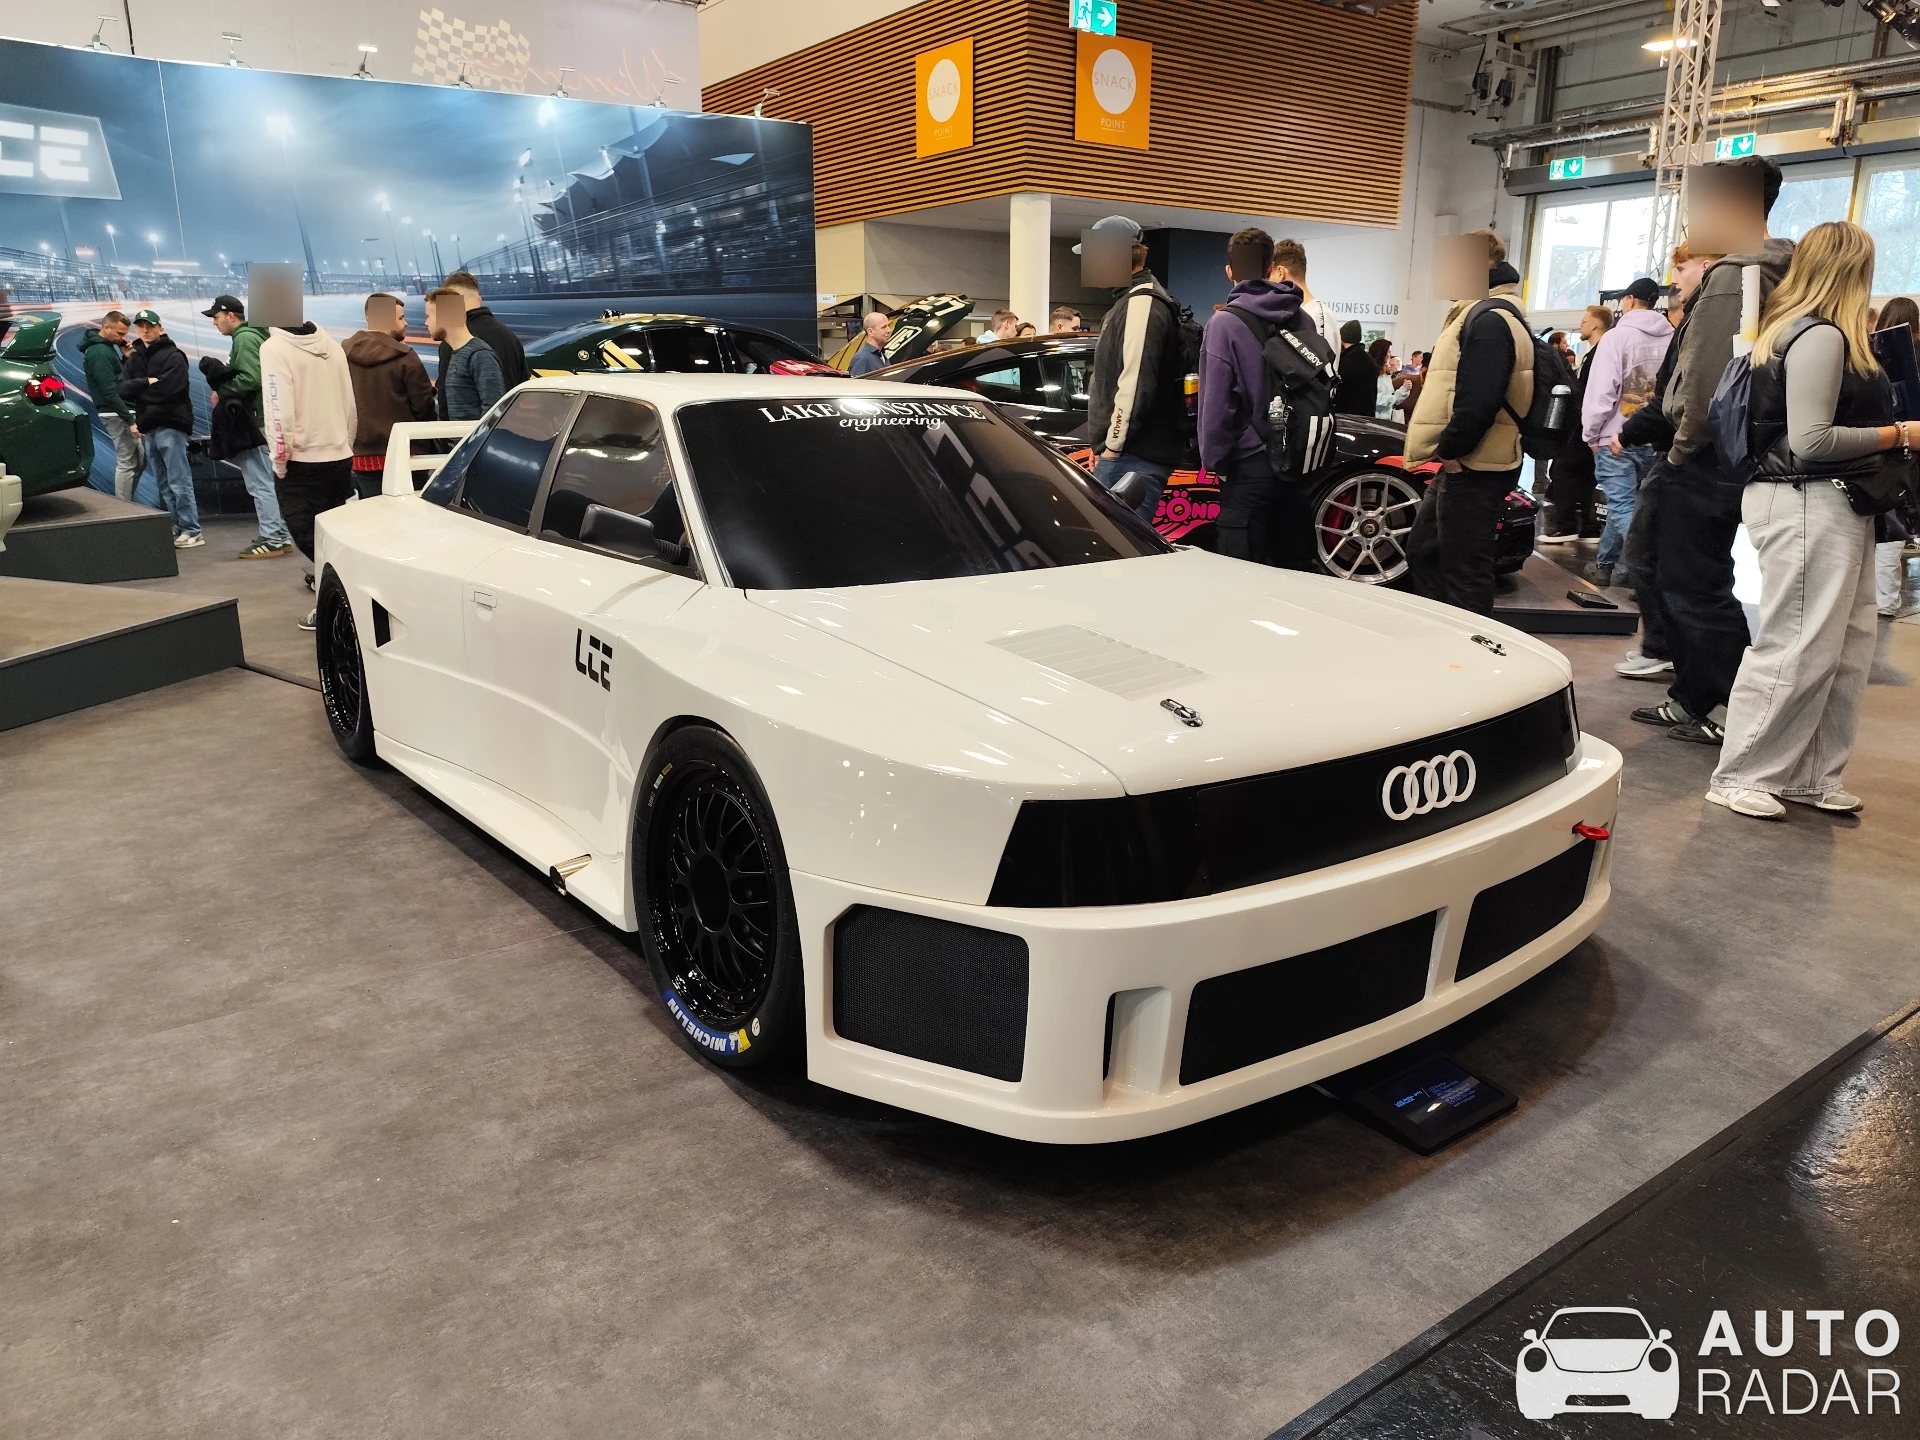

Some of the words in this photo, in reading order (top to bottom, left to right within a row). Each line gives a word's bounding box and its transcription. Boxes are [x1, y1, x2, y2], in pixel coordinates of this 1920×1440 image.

[928, 82, 959, 101] SNACK
[1093, 72, 1135, 92] SNACK
[934, 125, 953, 137] POINT
[1100, 118, 1126, 129] POINT
[1323, 301, 1370, 314] USINESS
[1374, 304, 1399, 315] CLUB
[758, 403, 841, 423] LAKE
[839, 415, 945, 431] engineering
[1112, 408, 1124, 439] CANADA
[667, 998, 727, 1053] MICHELIN
